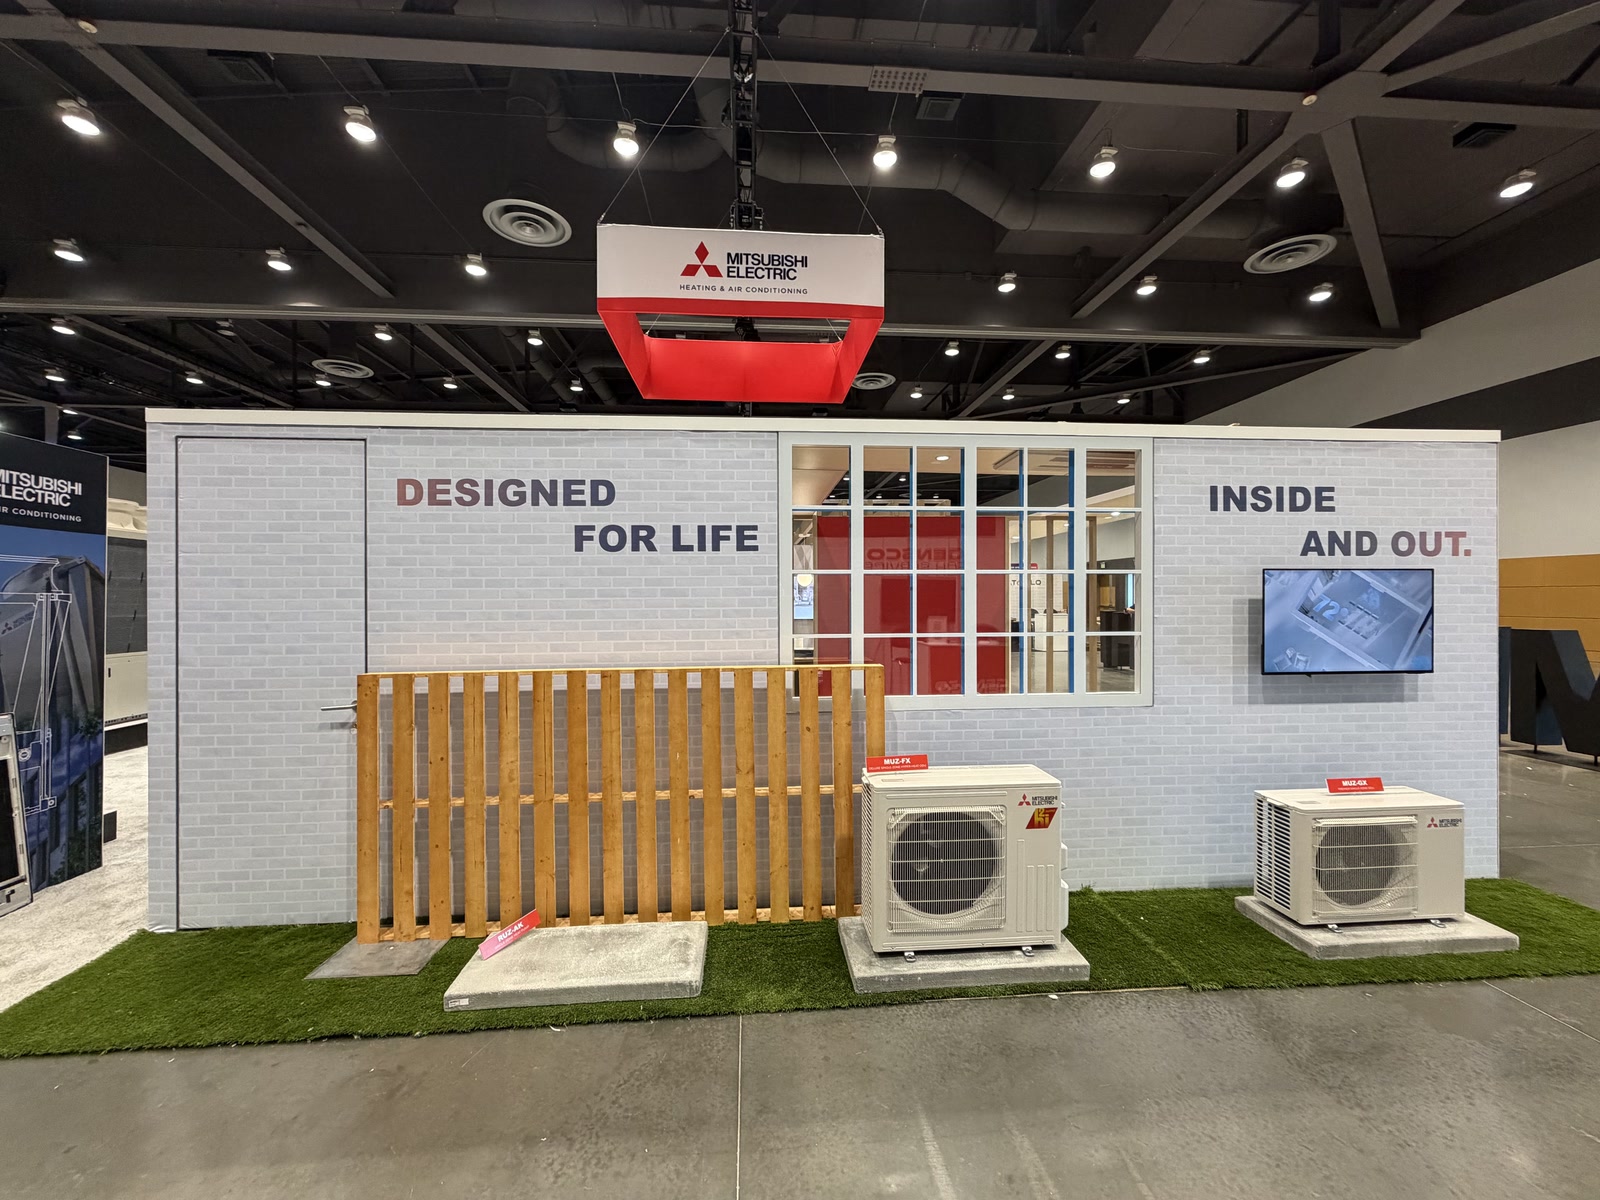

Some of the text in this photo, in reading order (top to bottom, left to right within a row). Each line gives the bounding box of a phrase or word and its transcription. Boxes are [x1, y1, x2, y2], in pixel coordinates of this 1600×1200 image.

[726, 252, 808, 268] MITSUBISHI
[726, 266, 797, 281] ELECTRIC
[679, 284, 717, 292] HEATING
[745, 286, 808, 295] CONDITIONING
[0, 468, 82, 496] ITSUBISHI
[396, 478, 616, 507] DESIGNED
[0, 483, 71, 507] LECTRIC
[1209, 485, 1336, 513] INSIDE
[12, 507, 82, 523] CONDITIONING
[574, 524, 759, 553] FOR LIFE
[1300, 530, 1472, 557] AND OUT.
[497, 921, 524, 942] RUZ-AK
